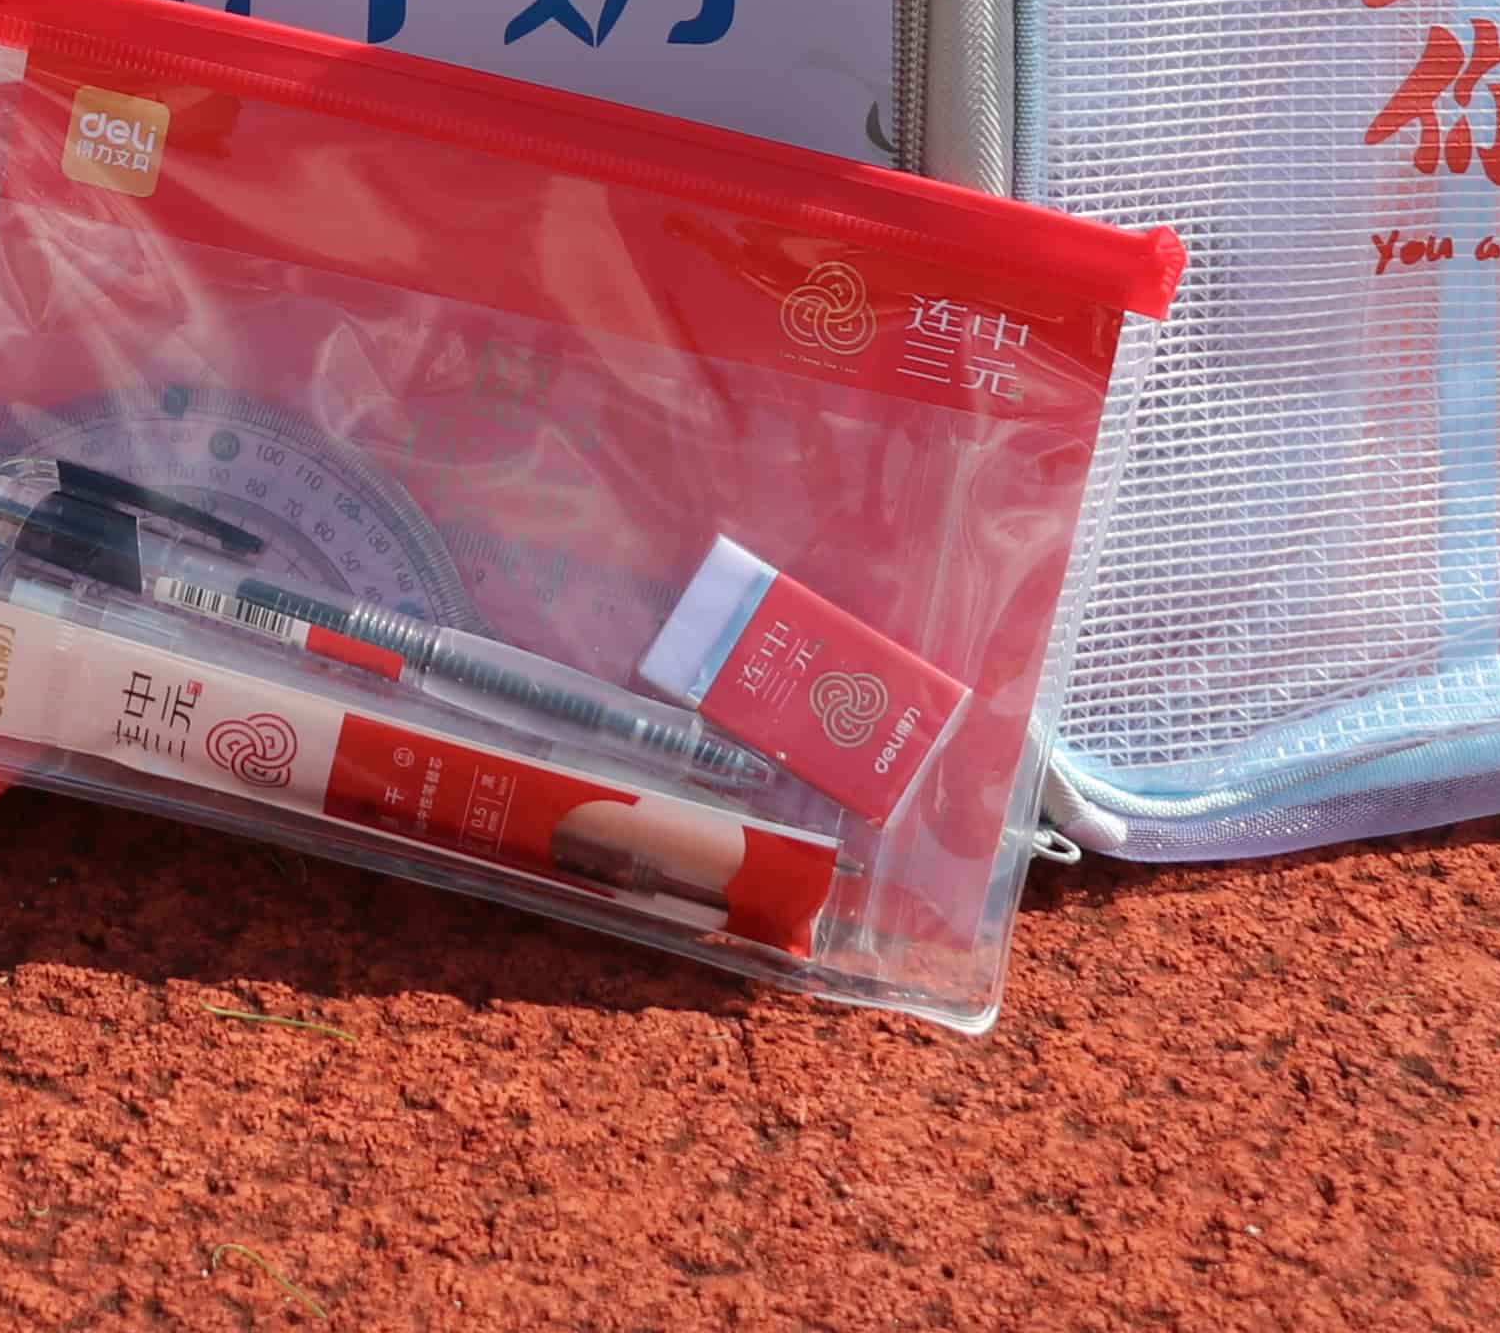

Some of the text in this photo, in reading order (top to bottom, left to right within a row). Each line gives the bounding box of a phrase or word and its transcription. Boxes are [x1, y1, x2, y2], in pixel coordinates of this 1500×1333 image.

[79, 111, 157, 153] deli
[905, 293, 1030, 351] 连中
[896, 339, 1026, 400] 三元
[255, 443, 286, 467] 100
[294, 463, 324, 492] 110
[366, 523, 391, 555] 130
[736, 619, 791, 696] 连中
[762, 636, 818, 713] 三元
[471, 806, 488, 829] 0.5
